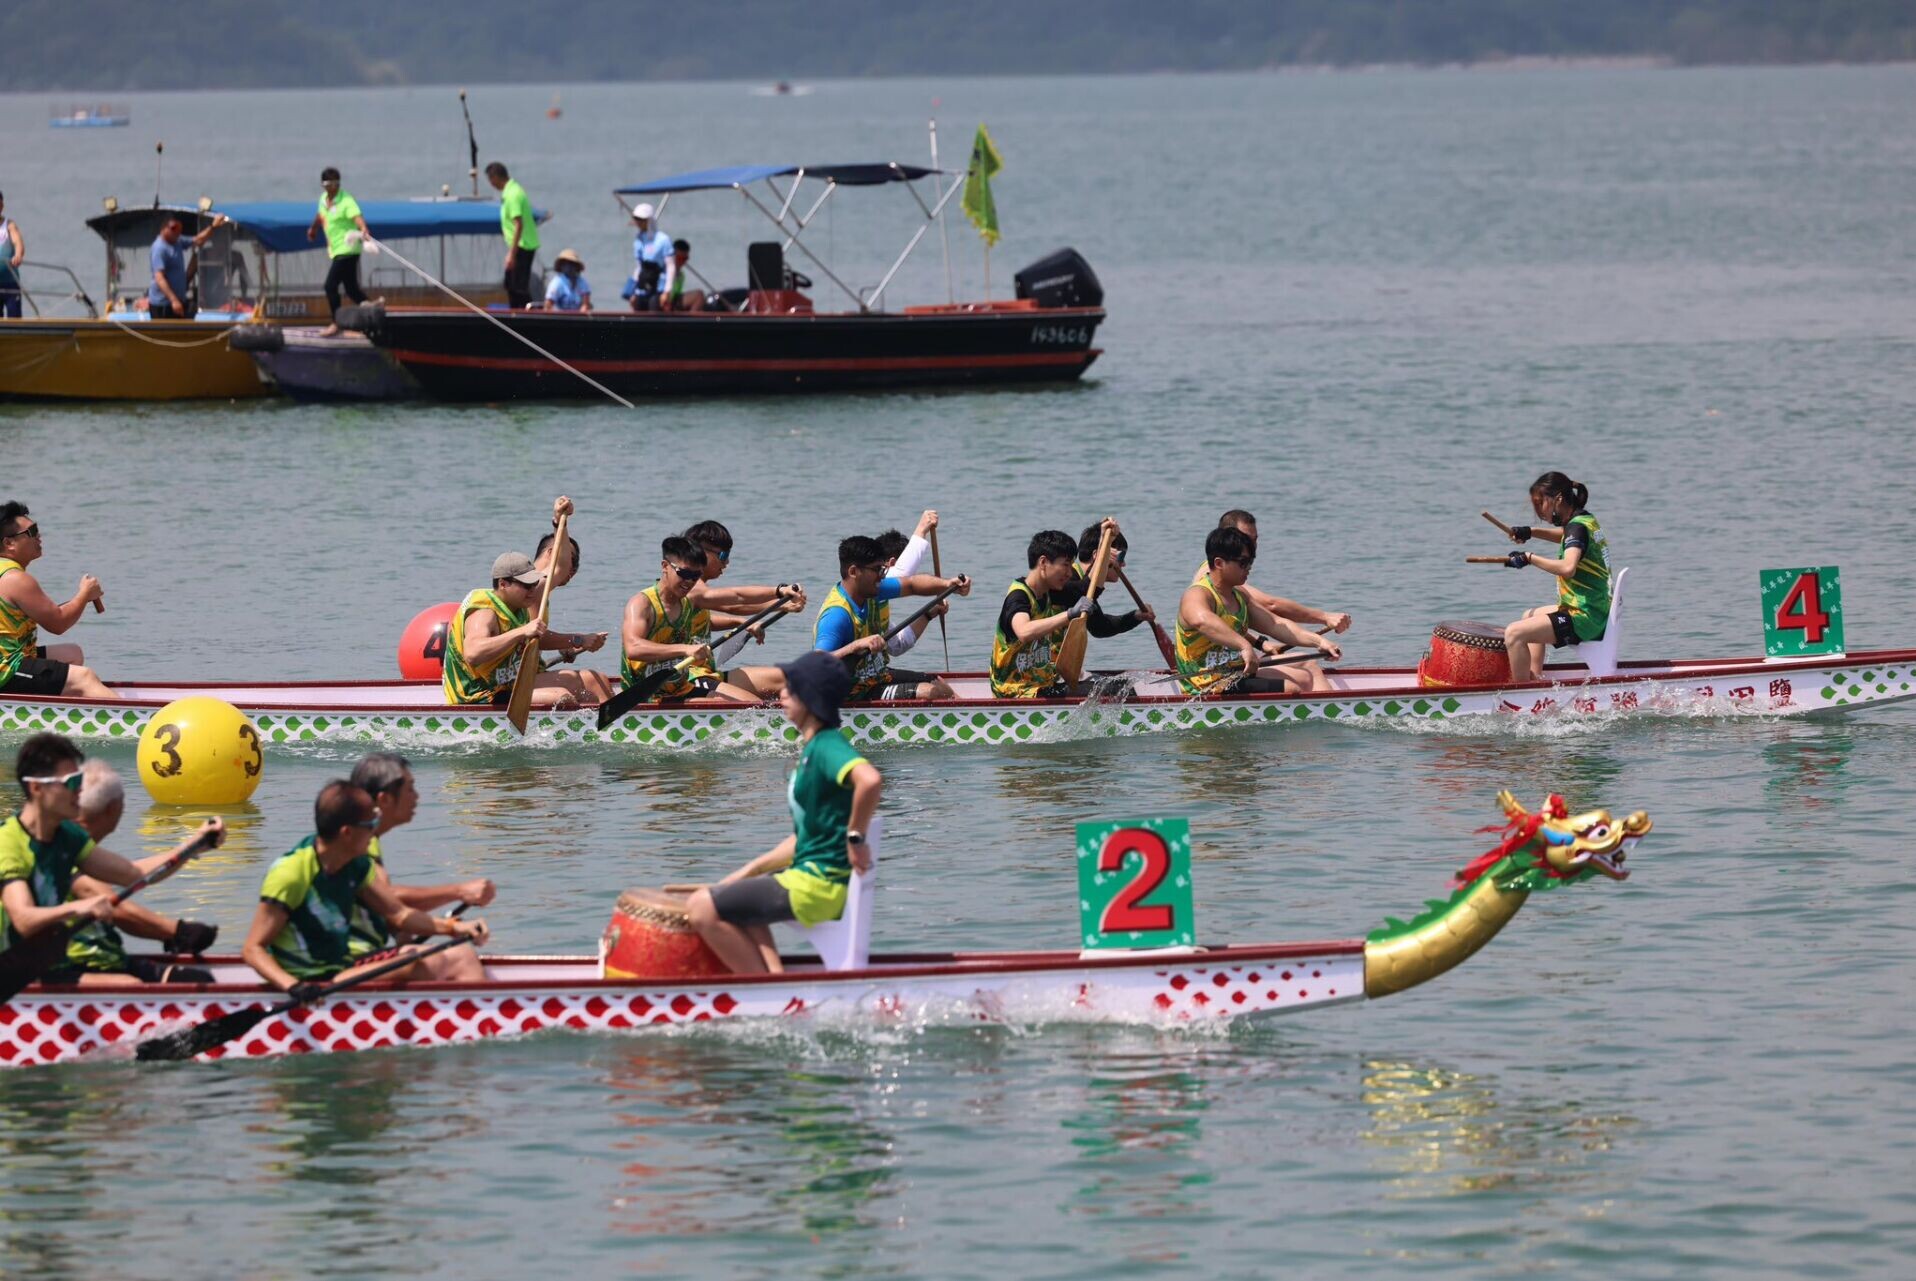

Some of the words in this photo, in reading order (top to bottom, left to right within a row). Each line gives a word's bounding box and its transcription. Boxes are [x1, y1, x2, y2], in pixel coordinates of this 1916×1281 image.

[1775, 572, 1830, 644] 4
[423, 621, 449, 668] 4
[151, 723, 183, 778] 3
[238, 723, 262, 778] 3
[1097, 827, 1175, 934] 2
